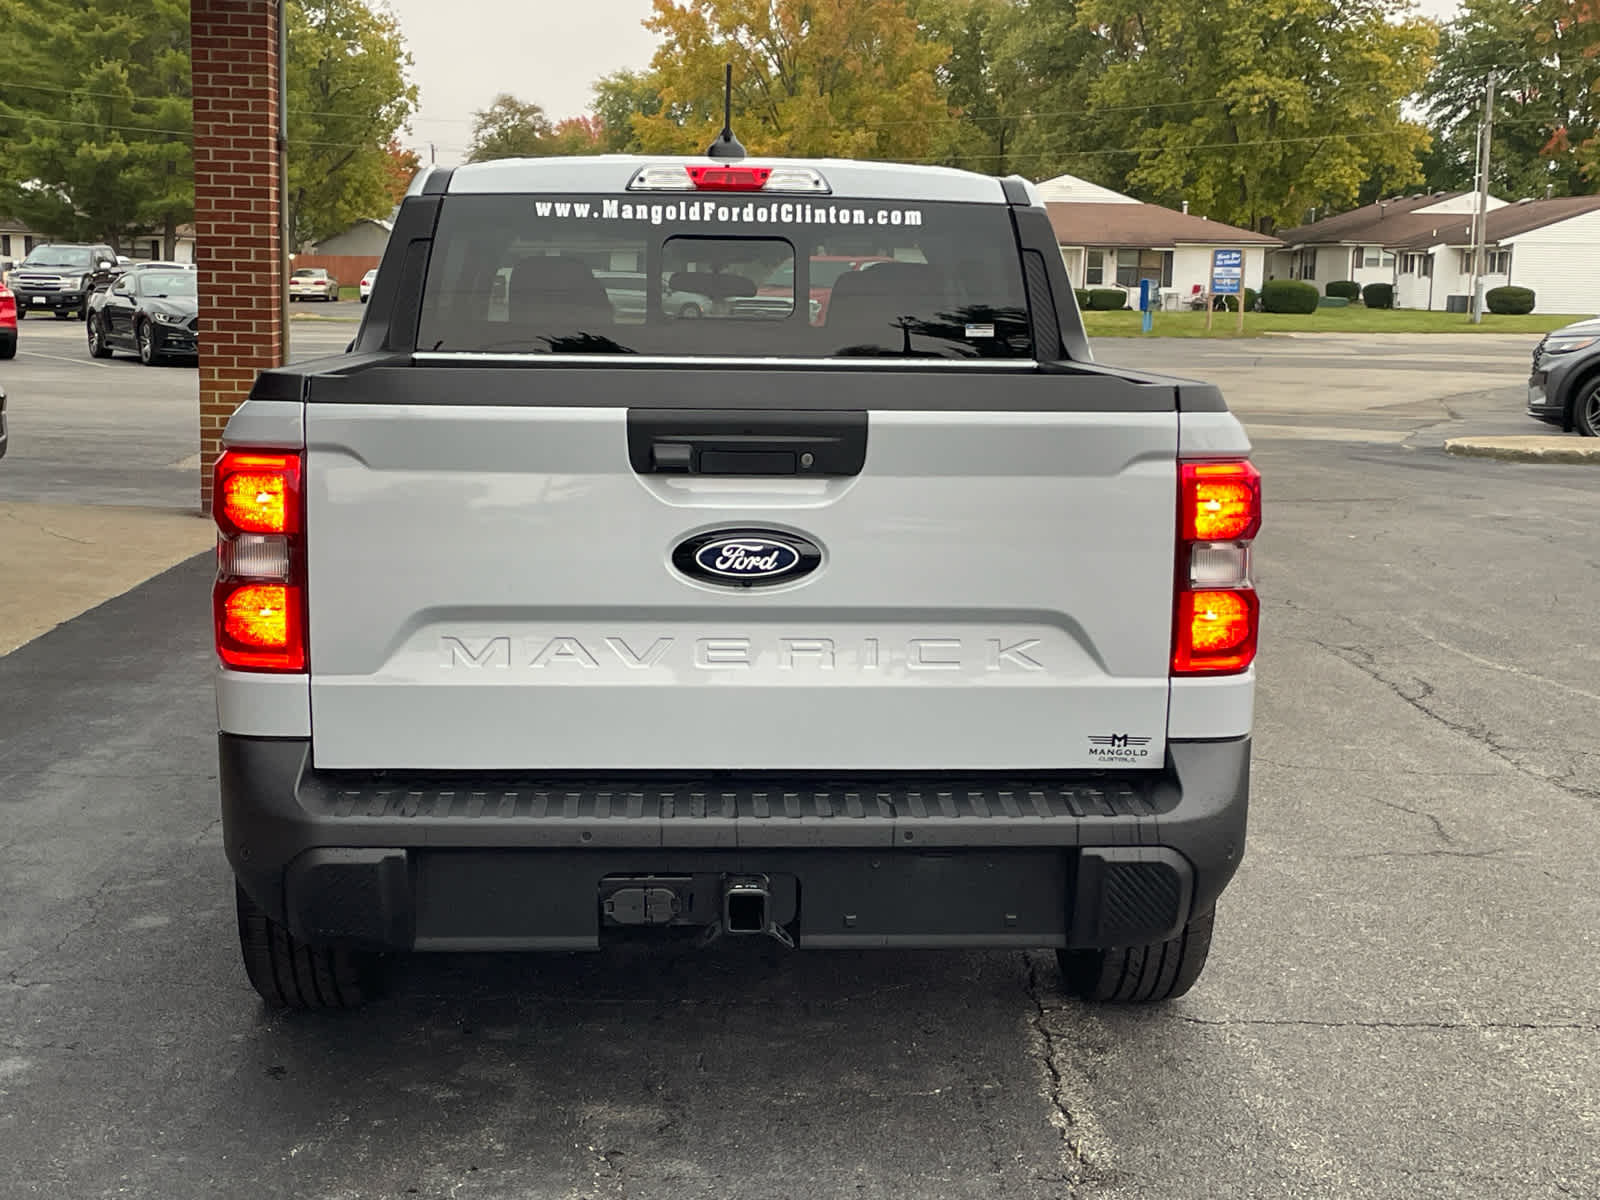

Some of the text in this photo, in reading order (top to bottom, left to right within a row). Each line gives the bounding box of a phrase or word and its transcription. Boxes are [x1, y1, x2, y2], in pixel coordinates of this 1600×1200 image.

[535, 200, 922, 225] www.MangoldFordofClinton.com
[715, 544, 779, 570] Ford
[440, 636, 1044, 670] MAVERICK
[1088, 748, 1148, 757] MANGOLD
